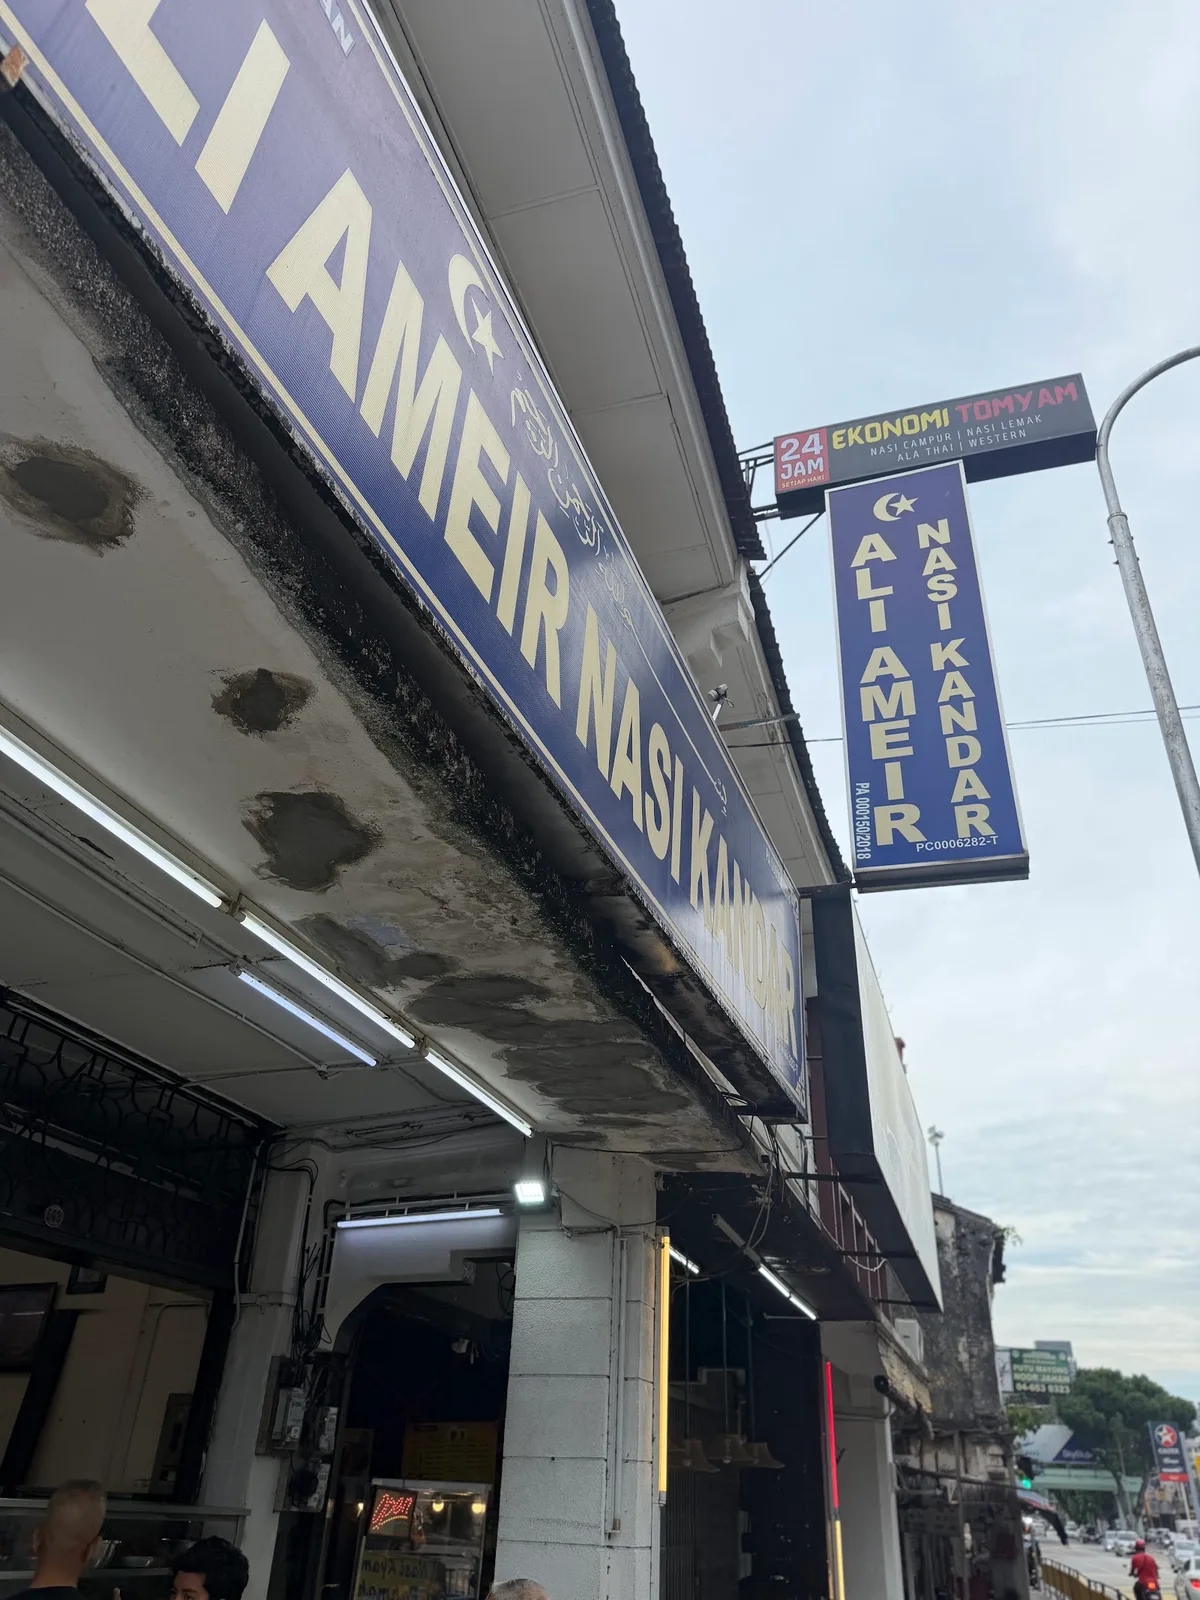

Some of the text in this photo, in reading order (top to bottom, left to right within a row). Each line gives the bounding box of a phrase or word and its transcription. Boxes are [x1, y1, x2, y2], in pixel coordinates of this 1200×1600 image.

[780, 432, 824, 462] 24
[832, 408, 950, 450] EKONOMI
[870, 414, 1042, 456] NASI CAMPUR NASI LEMAK
[897, 429, 1027, 462] ALA THAI WESTERN
[780, 457, 824, 480] JAM
[781, 474, 825, 489] SETIAP HARI
[266, 168, 568, 709] AMEIR
[576, 604, 684, 886] NASI
[690, 786, 798, 1061] KANDAR
[850, 533, 926, 846] ALI AMEIR
[917, 518, 996, 838] NASI KANDAR
[855, 782, 872, 860] PA 000150/2018
[916, 835, 999, 853] PC0006282-T
